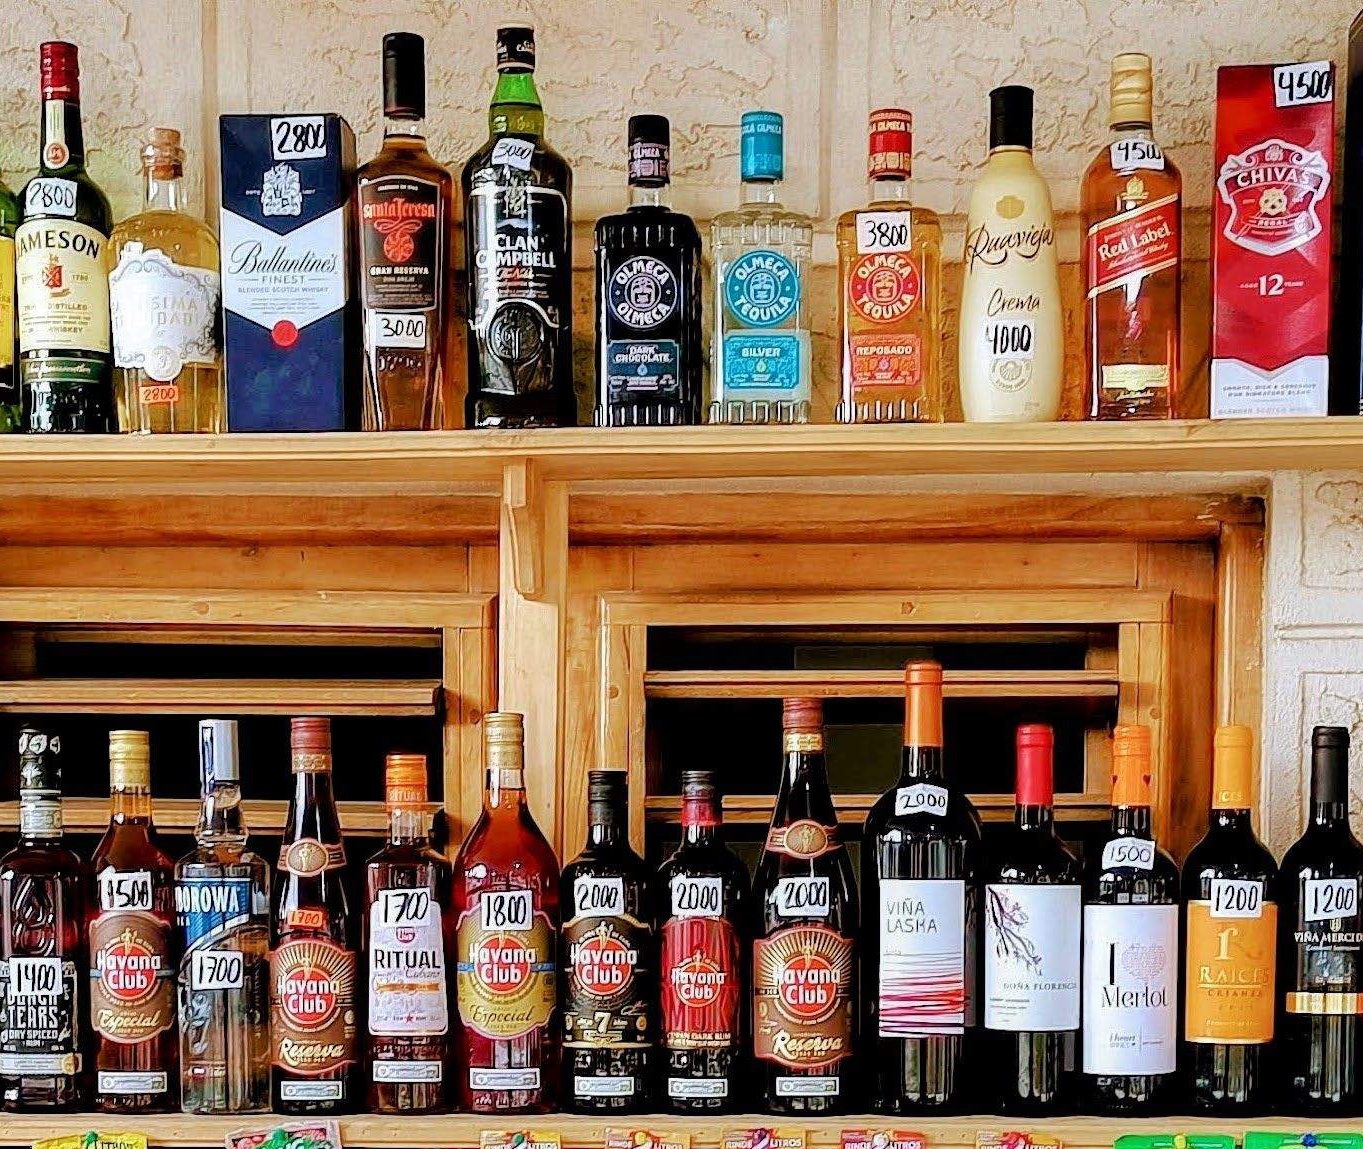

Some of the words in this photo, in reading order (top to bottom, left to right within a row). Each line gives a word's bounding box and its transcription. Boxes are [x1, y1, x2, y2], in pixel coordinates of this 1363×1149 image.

[1278, 70, 1331, 100] 4500
[276, 121, 326, 155] 2800
[1237, 166, 1312, 187] CHIVAS
[30, 182, 74, 209] 2800
[495, 234, 539, 250] CLAN
[865, 220, 908, 246] 3800
[1099, 242, 1127, 261] Red
[1129, 223, 1172, 251] Label
[261, 275, 306, 284] FINEST
[1259, 275, 1284, 296] 12
[381, 318, 424, 337] 3000
[742, 347, 780, 357] SILVER
[856, 345, 913, 356] REPOSADO
[144, 386, 176, 401] 2800
[900, 793, 947, 810] 2000
[1109, 845, 1151, 863] 1500
[383, 891, 430, 922] 1700
[887, 898, 925, 915] VIÑA
[1215, 884, 1259, 913] 1200
[1313, 884, 1354, 914] 1200
[292, 912, 320, 924] 1700
[485, 895, 527, 926] 1800
[97, 953, 161, 970] Havana
[374, 947, 441, 969] RITUAL
[470, 947, 537, 966] Havana
[108, 970, 148, 990] Club
[682, 983, 713, 999] Club
[786, 984, 827, 1005] Club
[7, 1006, 58, 1028] TEARS
[99, 1008, 160, 1029] Especial
[594, 1012, 612, 1036] 7
